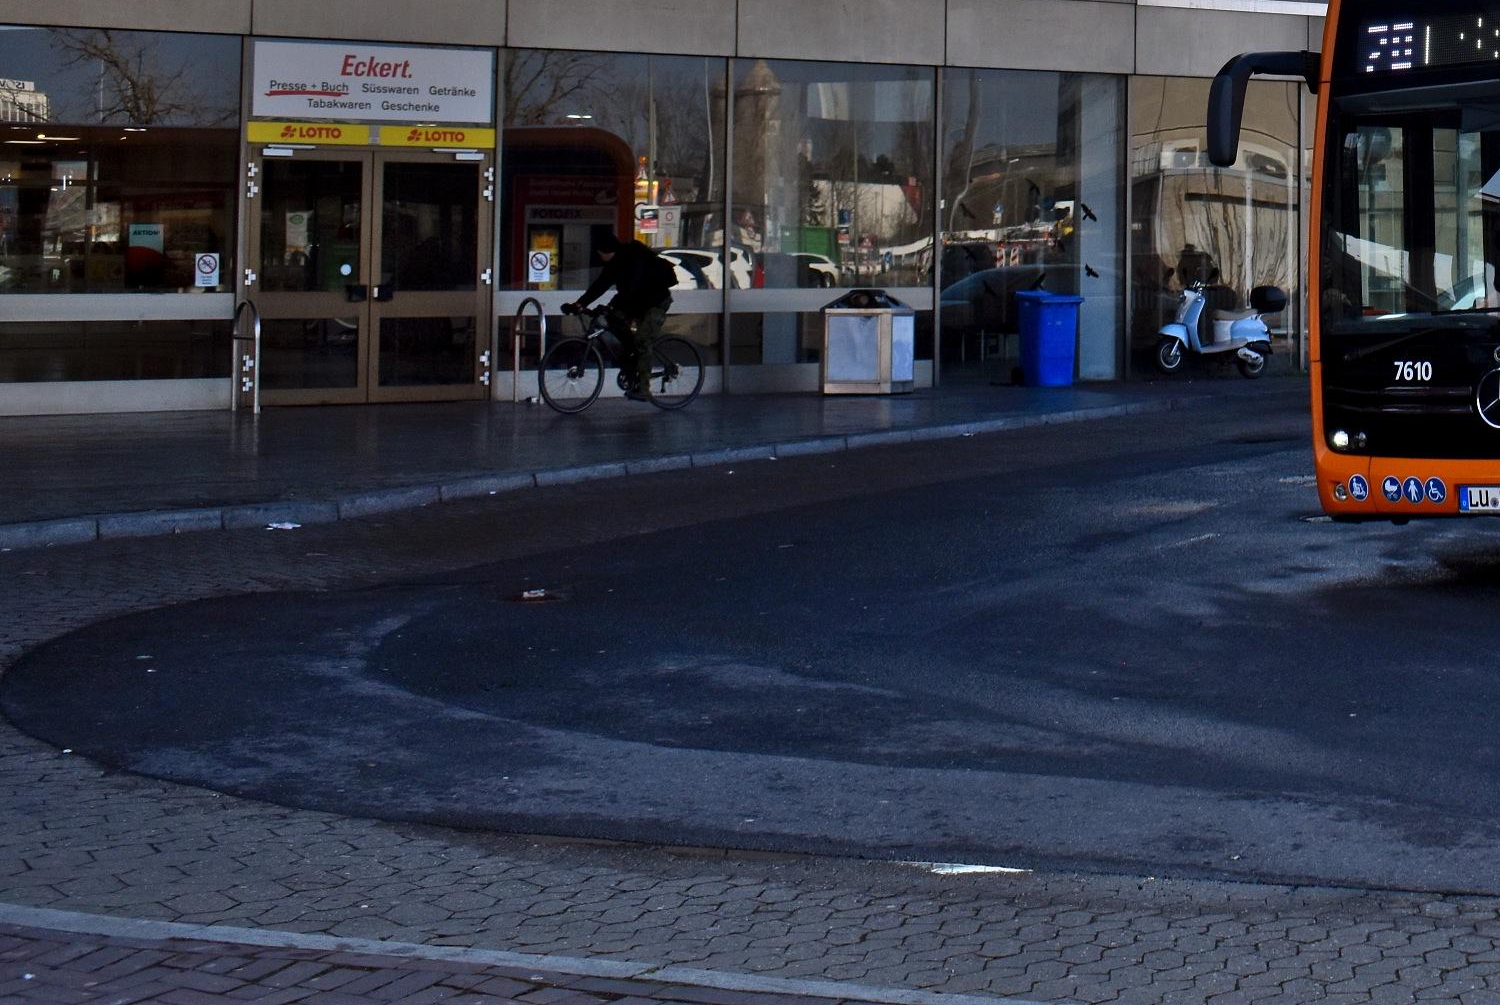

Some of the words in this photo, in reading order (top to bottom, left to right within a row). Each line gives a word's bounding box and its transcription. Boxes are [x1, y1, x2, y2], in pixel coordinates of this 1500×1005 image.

[340, 54, 413, 79] Eckert.
[269, 80, 307, 92] Presse
[321, 82, 349, 92] Buch
[361, 82, 420, 95] Süsswaren
[428, 85, 477, 97] Getränke
[307, 98, 372, 110] Tabakwaren
[381, 101, 440, 113] Geschenke
[299, 127, 342, 139] LOTTO
[424, 130, 465, 143] LOTTO
[1393, 361, 1433, 381] 7610
[1468, 490, 1489, 508] LU
